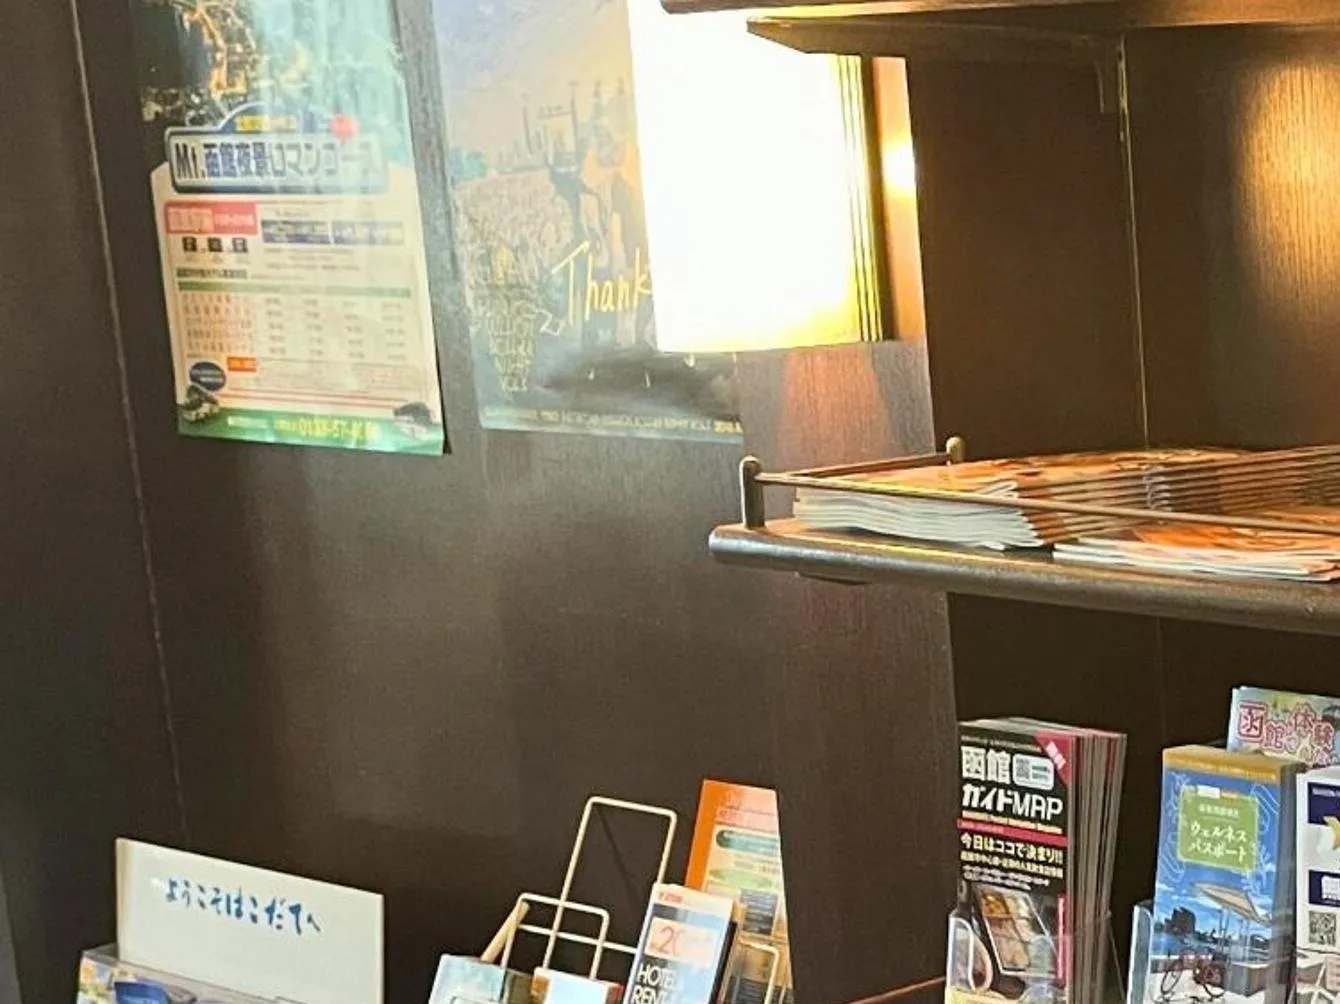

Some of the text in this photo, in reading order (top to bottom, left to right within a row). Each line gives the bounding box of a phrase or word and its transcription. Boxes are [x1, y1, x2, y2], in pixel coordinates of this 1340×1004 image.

[960, 745, 1010, 785] 函館
[962, 783, 1064, 821] ガイドMAP
[165, 877, 321, 937] ようこそはこだてへ
